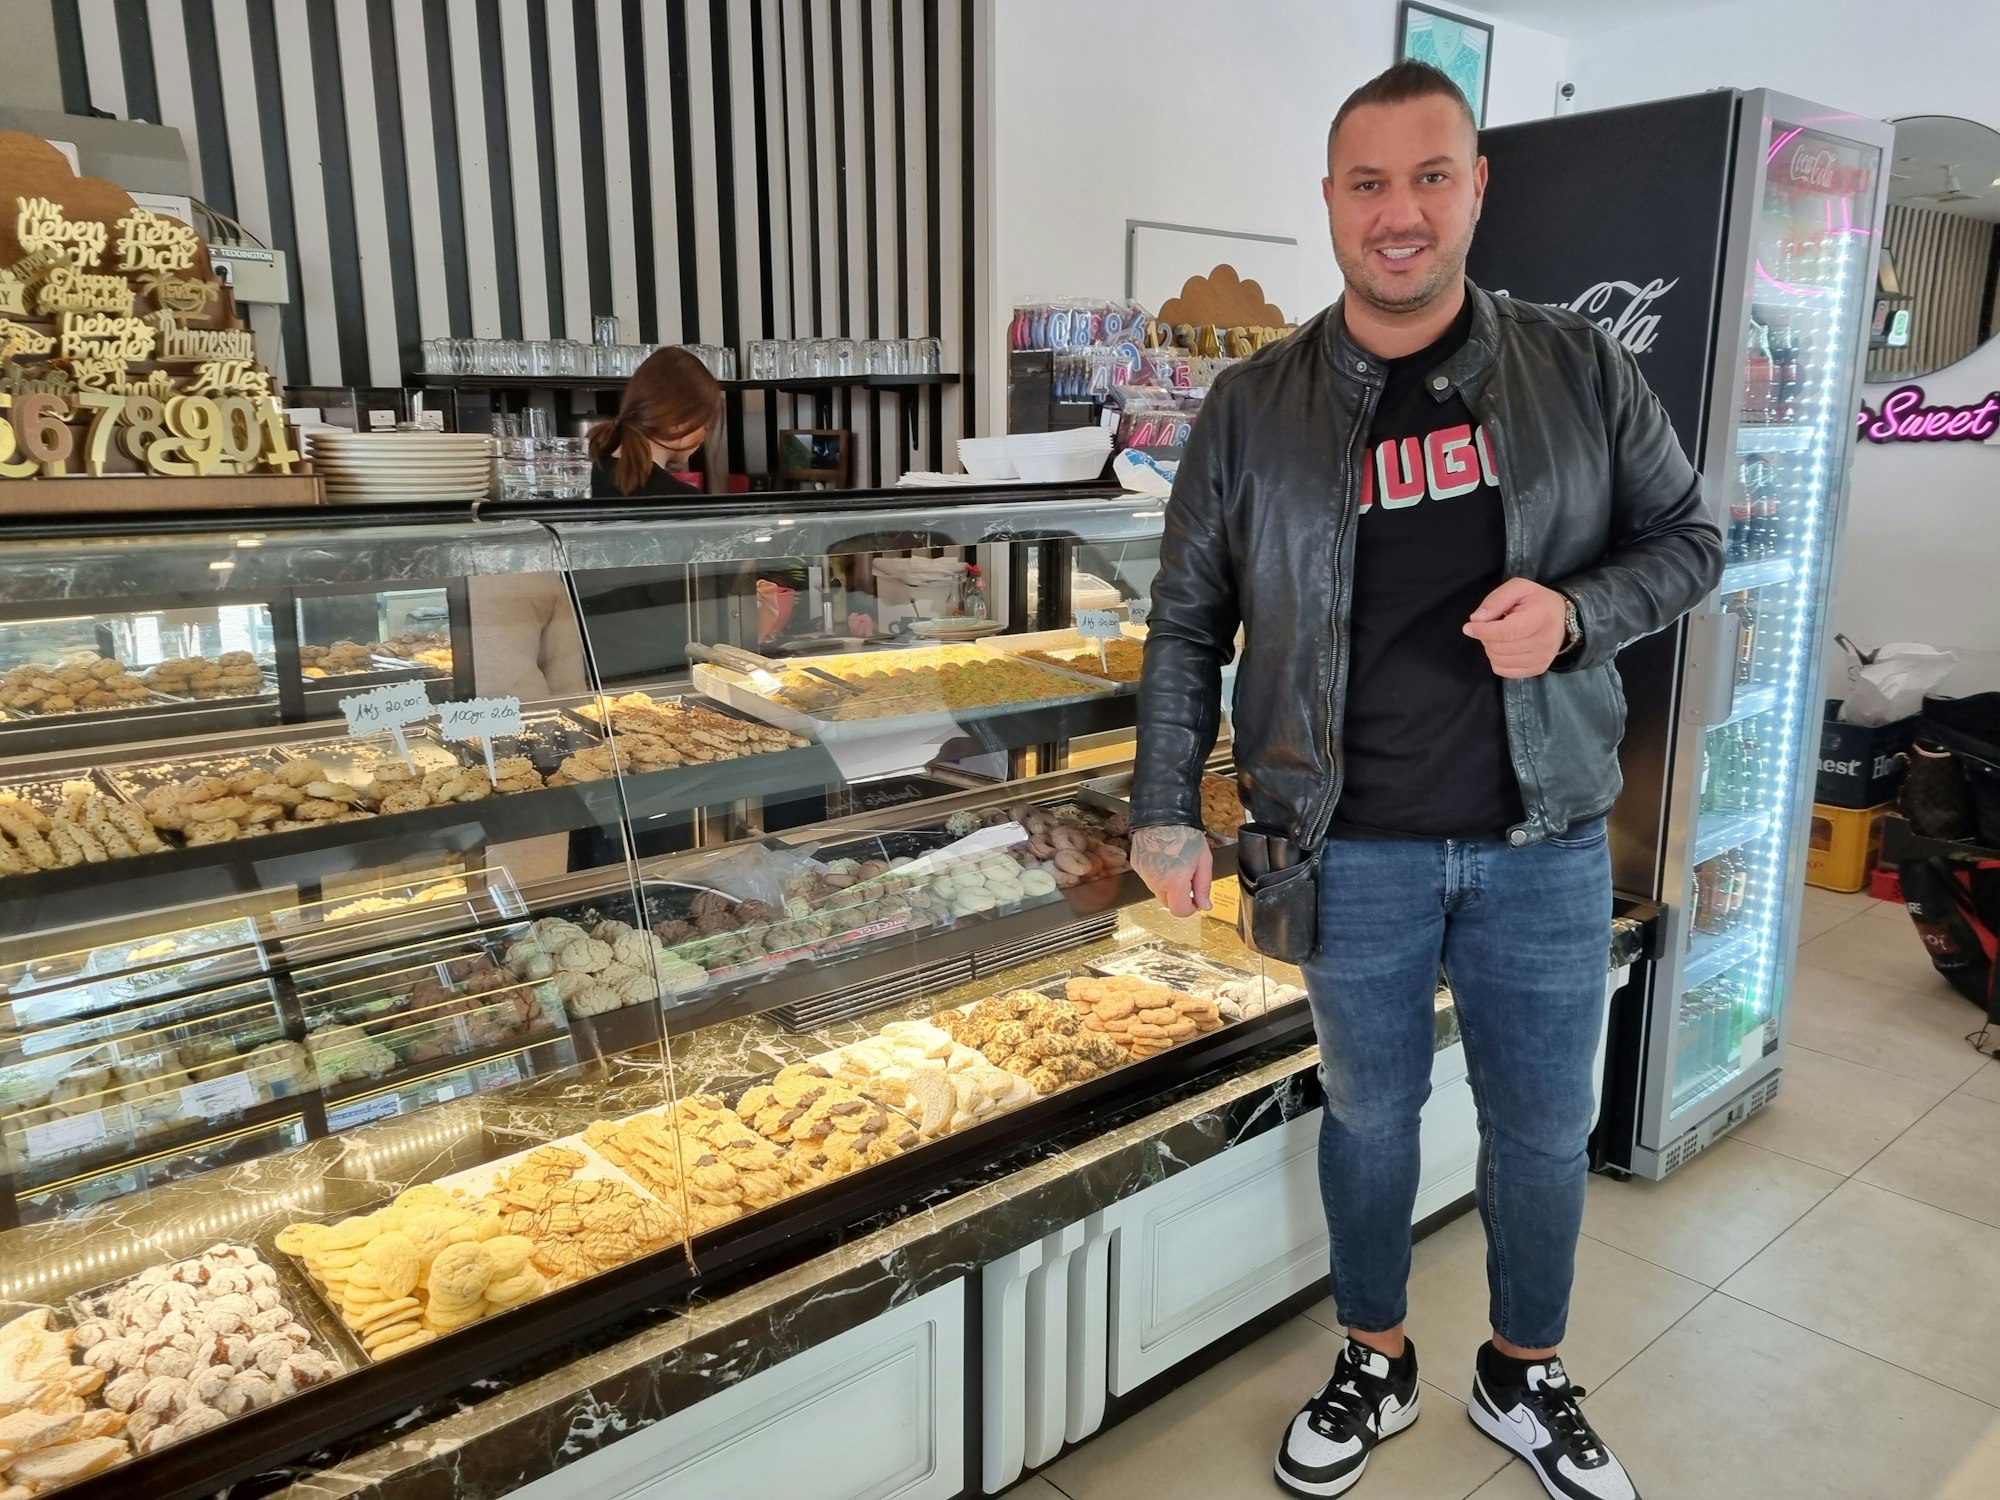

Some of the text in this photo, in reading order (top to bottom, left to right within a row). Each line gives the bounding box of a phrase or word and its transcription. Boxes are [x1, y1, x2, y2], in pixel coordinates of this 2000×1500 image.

[16, 196, 64, 220] Wir
[18, 212, 109, 242] Lieben
[115, 238, 198, 271] Dich
[221, 249, 273, 261] TEDDINGTON
[63, 311, 143, 338] Lieber
[161, 316, 255, 360] Prinzessin
[61, 333, 156, 361] Bruder
[181, 361, 270, 391] Alles
[1868, 390, 1999, 438] Sweet
